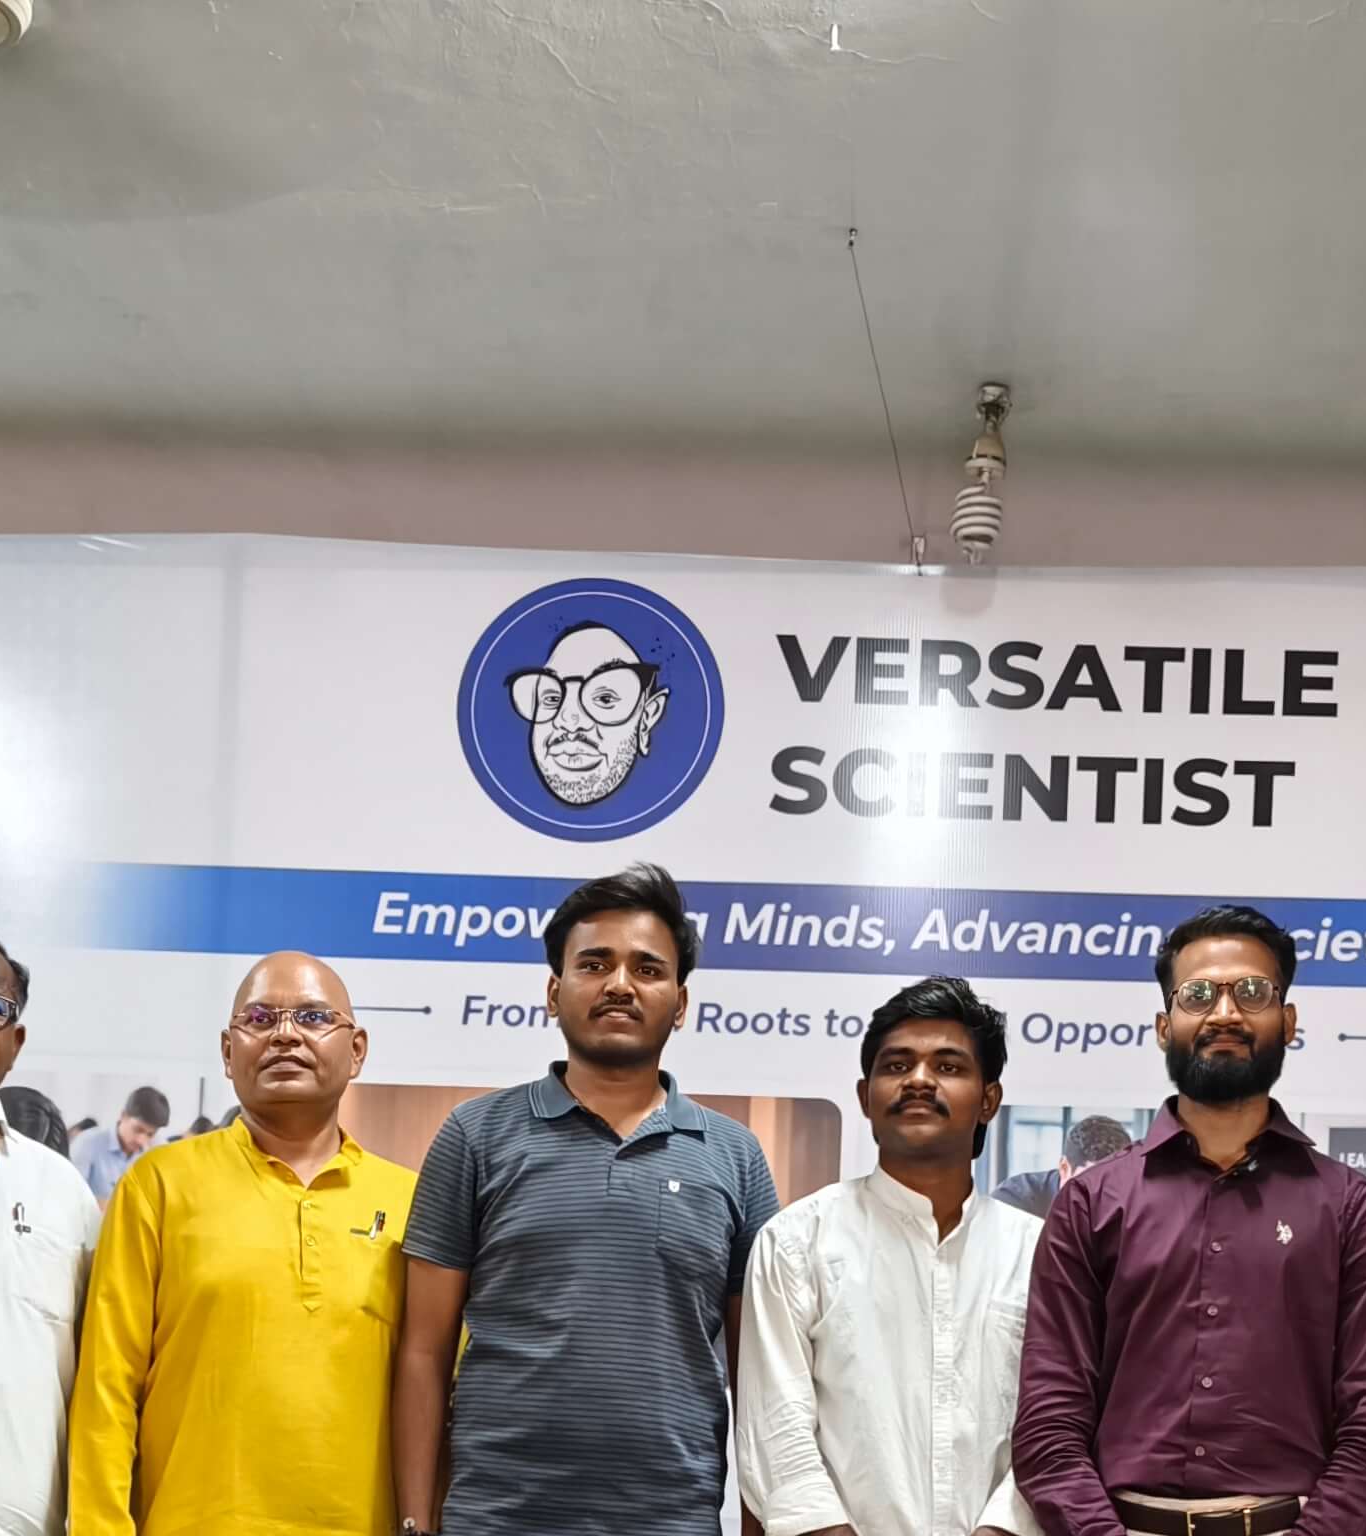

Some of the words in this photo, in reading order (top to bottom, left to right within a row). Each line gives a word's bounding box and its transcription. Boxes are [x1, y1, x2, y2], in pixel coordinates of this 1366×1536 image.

[776, 634, 1339, 718] VERSATILE
[770, 746, 1296, 828] SCIENTIST
[723, 902, 896, 956] Minds,
[912, 909, 1175, 957] Advancin
[696, 1002, 811, 1038] Roots
[824, 1012, 864, 1038] to
